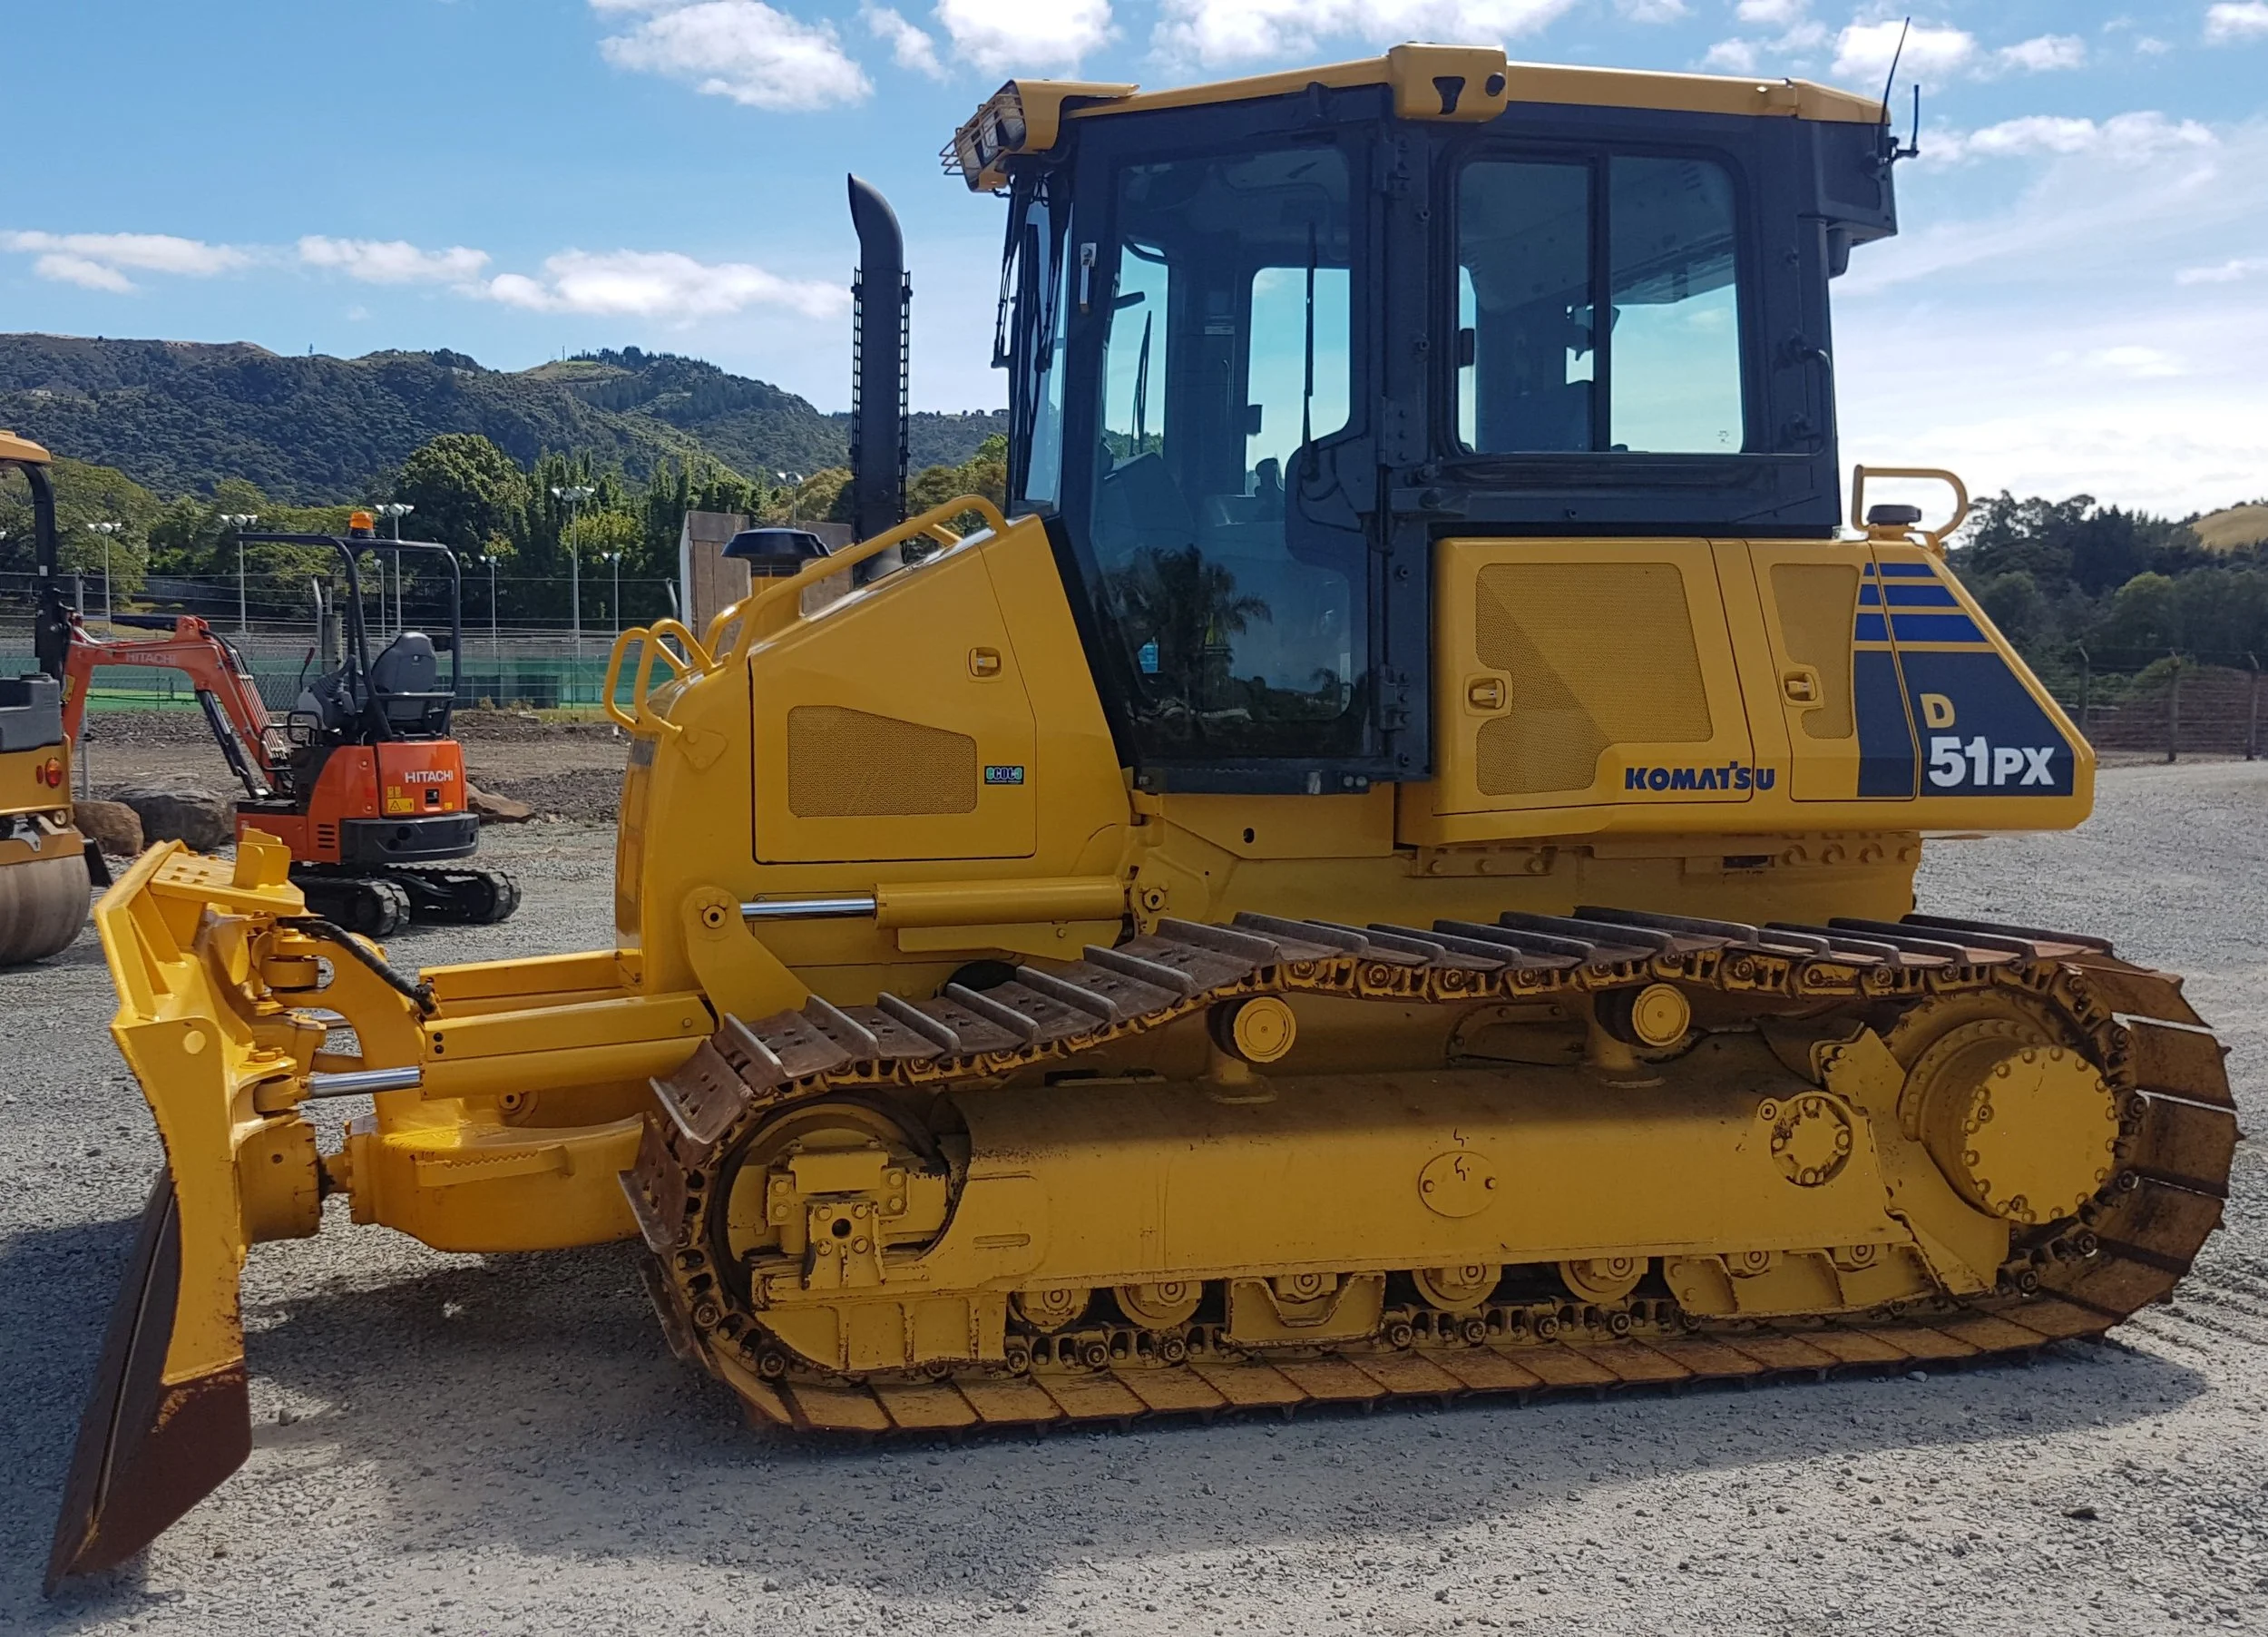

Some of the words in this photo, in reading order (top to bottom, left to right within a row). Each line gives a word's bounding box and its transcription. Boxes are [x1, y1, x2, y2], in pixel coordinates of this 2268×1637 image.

[126, 652, 177, 664] HITACHI
[1920, 693, 1956, 729] D
[405, 769, 454, 783] HITACHI
[1625, 760, 1775, 791] KOMATSU
[1928, 736, 2055, 788] 51PX
